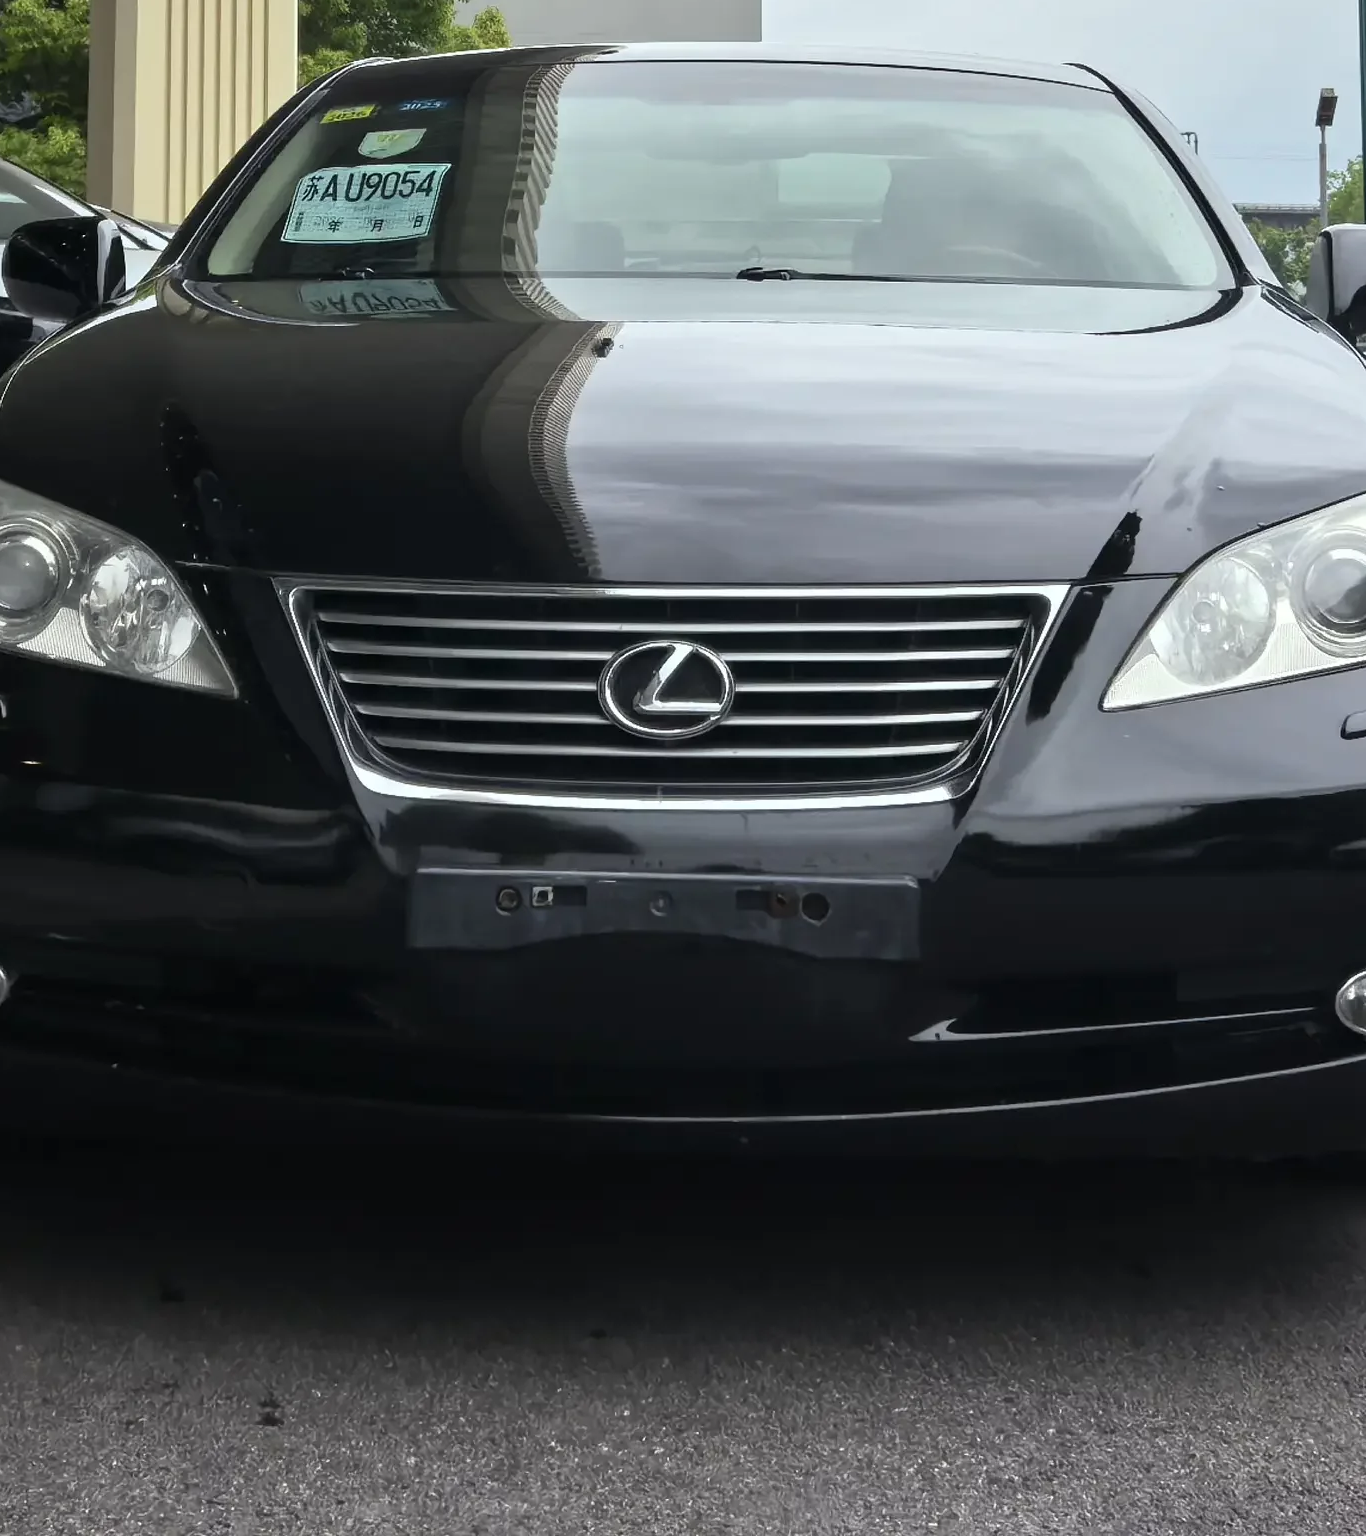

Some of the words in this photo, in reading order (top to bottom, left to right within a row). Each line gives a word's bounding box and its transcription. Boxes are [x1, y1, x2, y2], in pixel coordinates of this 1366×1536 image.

[301, 170, 437, 202] 苏AU9054
[328, 219, 343, 233] 年
[370, 219, 384, 232] 月
[413, 215, 424, 229] 日
